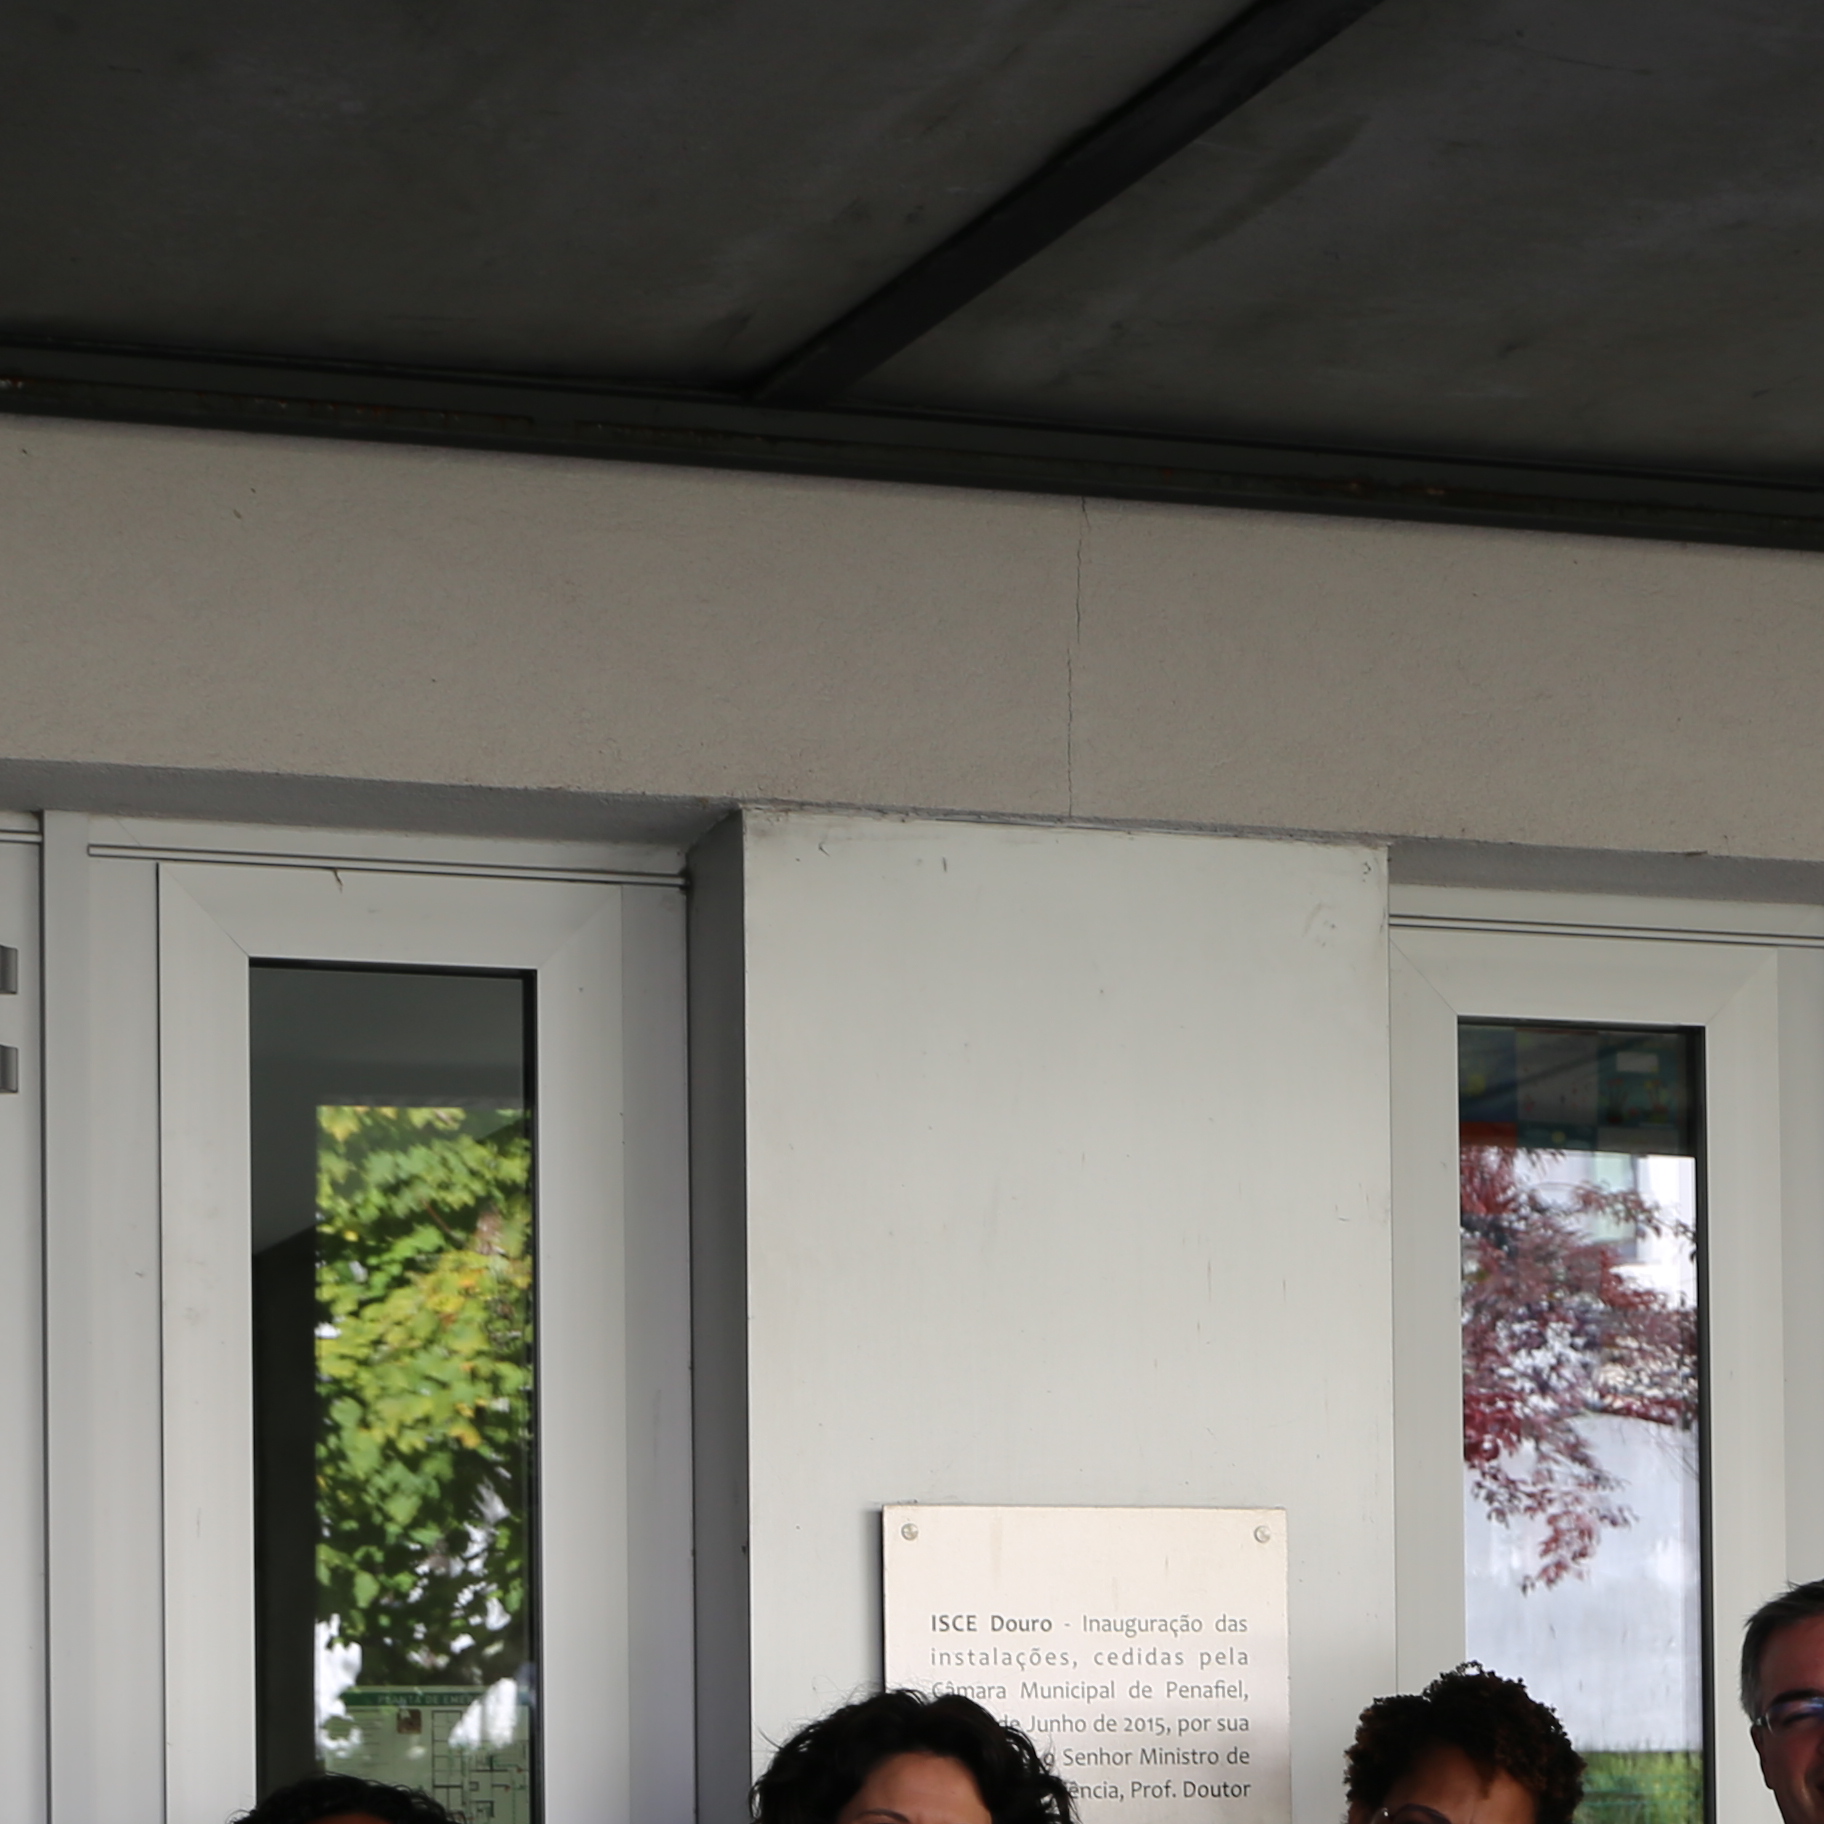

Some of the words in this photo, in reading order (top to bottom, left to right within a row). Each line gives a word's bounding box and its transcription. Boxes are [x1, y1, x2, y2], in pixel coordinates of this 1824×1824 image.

[931, 1615, 977, 1632] ISCE
[990, 1615, 1052, 1633] Douro
[1082, 1614, 1203, 1638] Inauguração
[1215, 1614, 1248, 1633] das
[931, 1648, 1078, 1671] instalações,
[1094, 1648, 1185, 1666] cedidas
[1200, 1648, 1249, 1671] pela
[1021, 1681, 1116, 1704] Municipal
[1128, 1681, 1153, 1699] de
[1166, 1681, 1249, 1702] Penafiel,
[1026, 1713, 1087, 1732] Junho
[1093, 1713, 1118, 1732] de
[1123, 1717, 1172, 1736] 2015,
[1178, 1718, 1211, 1738] por
[1217, 1718, 1250, 1732] sua
[1063, 1747, 1133, 1766] Senhor
[1139, 1747, 1219, 1766] Ministro
[1226, 1747, 1250, 1766] de
[1131, 1781, 1177, 1799] Prof.
[1183, 1780, 1252, 1799] Doutor
